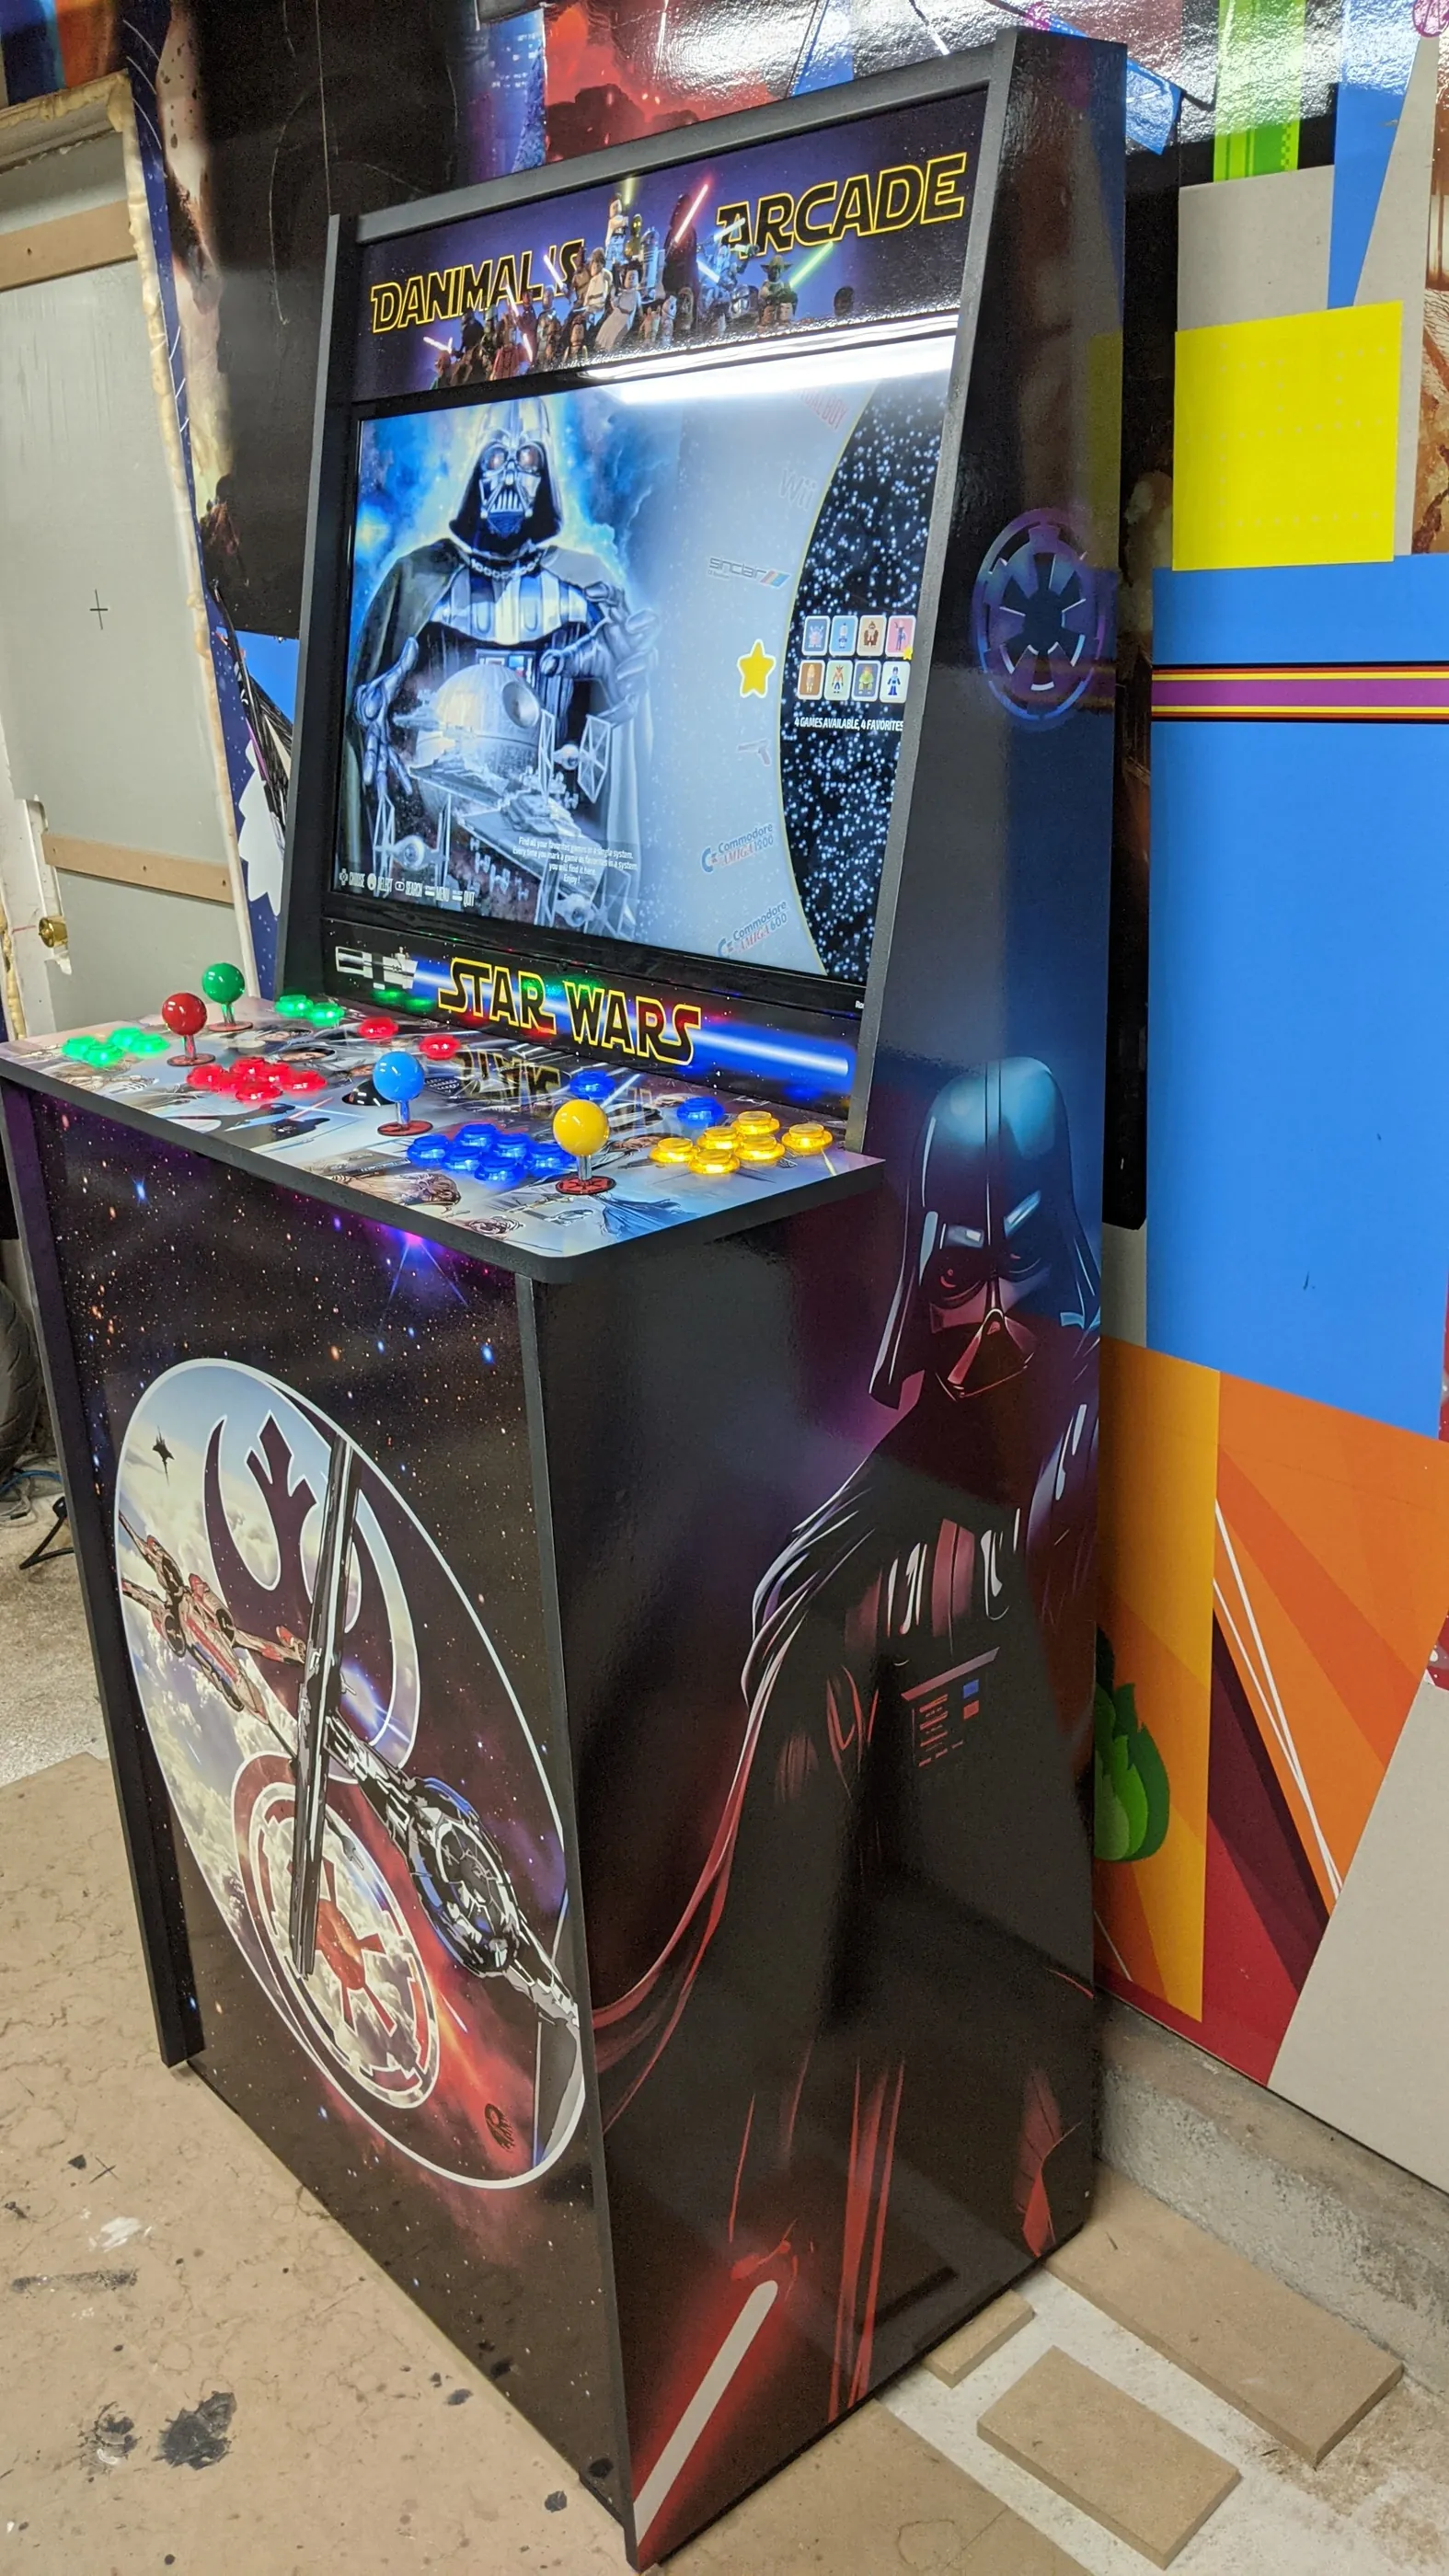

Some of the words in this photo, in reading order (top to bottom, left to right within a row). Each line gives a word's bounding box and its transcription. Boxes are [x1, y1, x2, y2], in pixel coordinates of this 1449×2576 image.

[716, 152, 967, 259] ARCADE
[779, 467, 817, 512] Wii
[794, 718, 799, 727] 4
[800, 717, 822, 728] GAMES
[822, 718, 860, 730] AVAILABLE,
[860, 719, 866, 730] 4
[867, 719, 903, 731] FAVORITES
[719, 824, 773, 854] Commodore
[723, 843, 754, 865] AMIGA
[563, 873, 577, 885] Enjoy
[464, 891, 475, 907] QUIT
[733, 902, 787, 941] Commodore
[740, 926, 770, 952] AMIGA
[769, 913, 788, 931] 600
[438, 957, 557, 1036] STAR
[564, 981, 701, 1066] WARS
